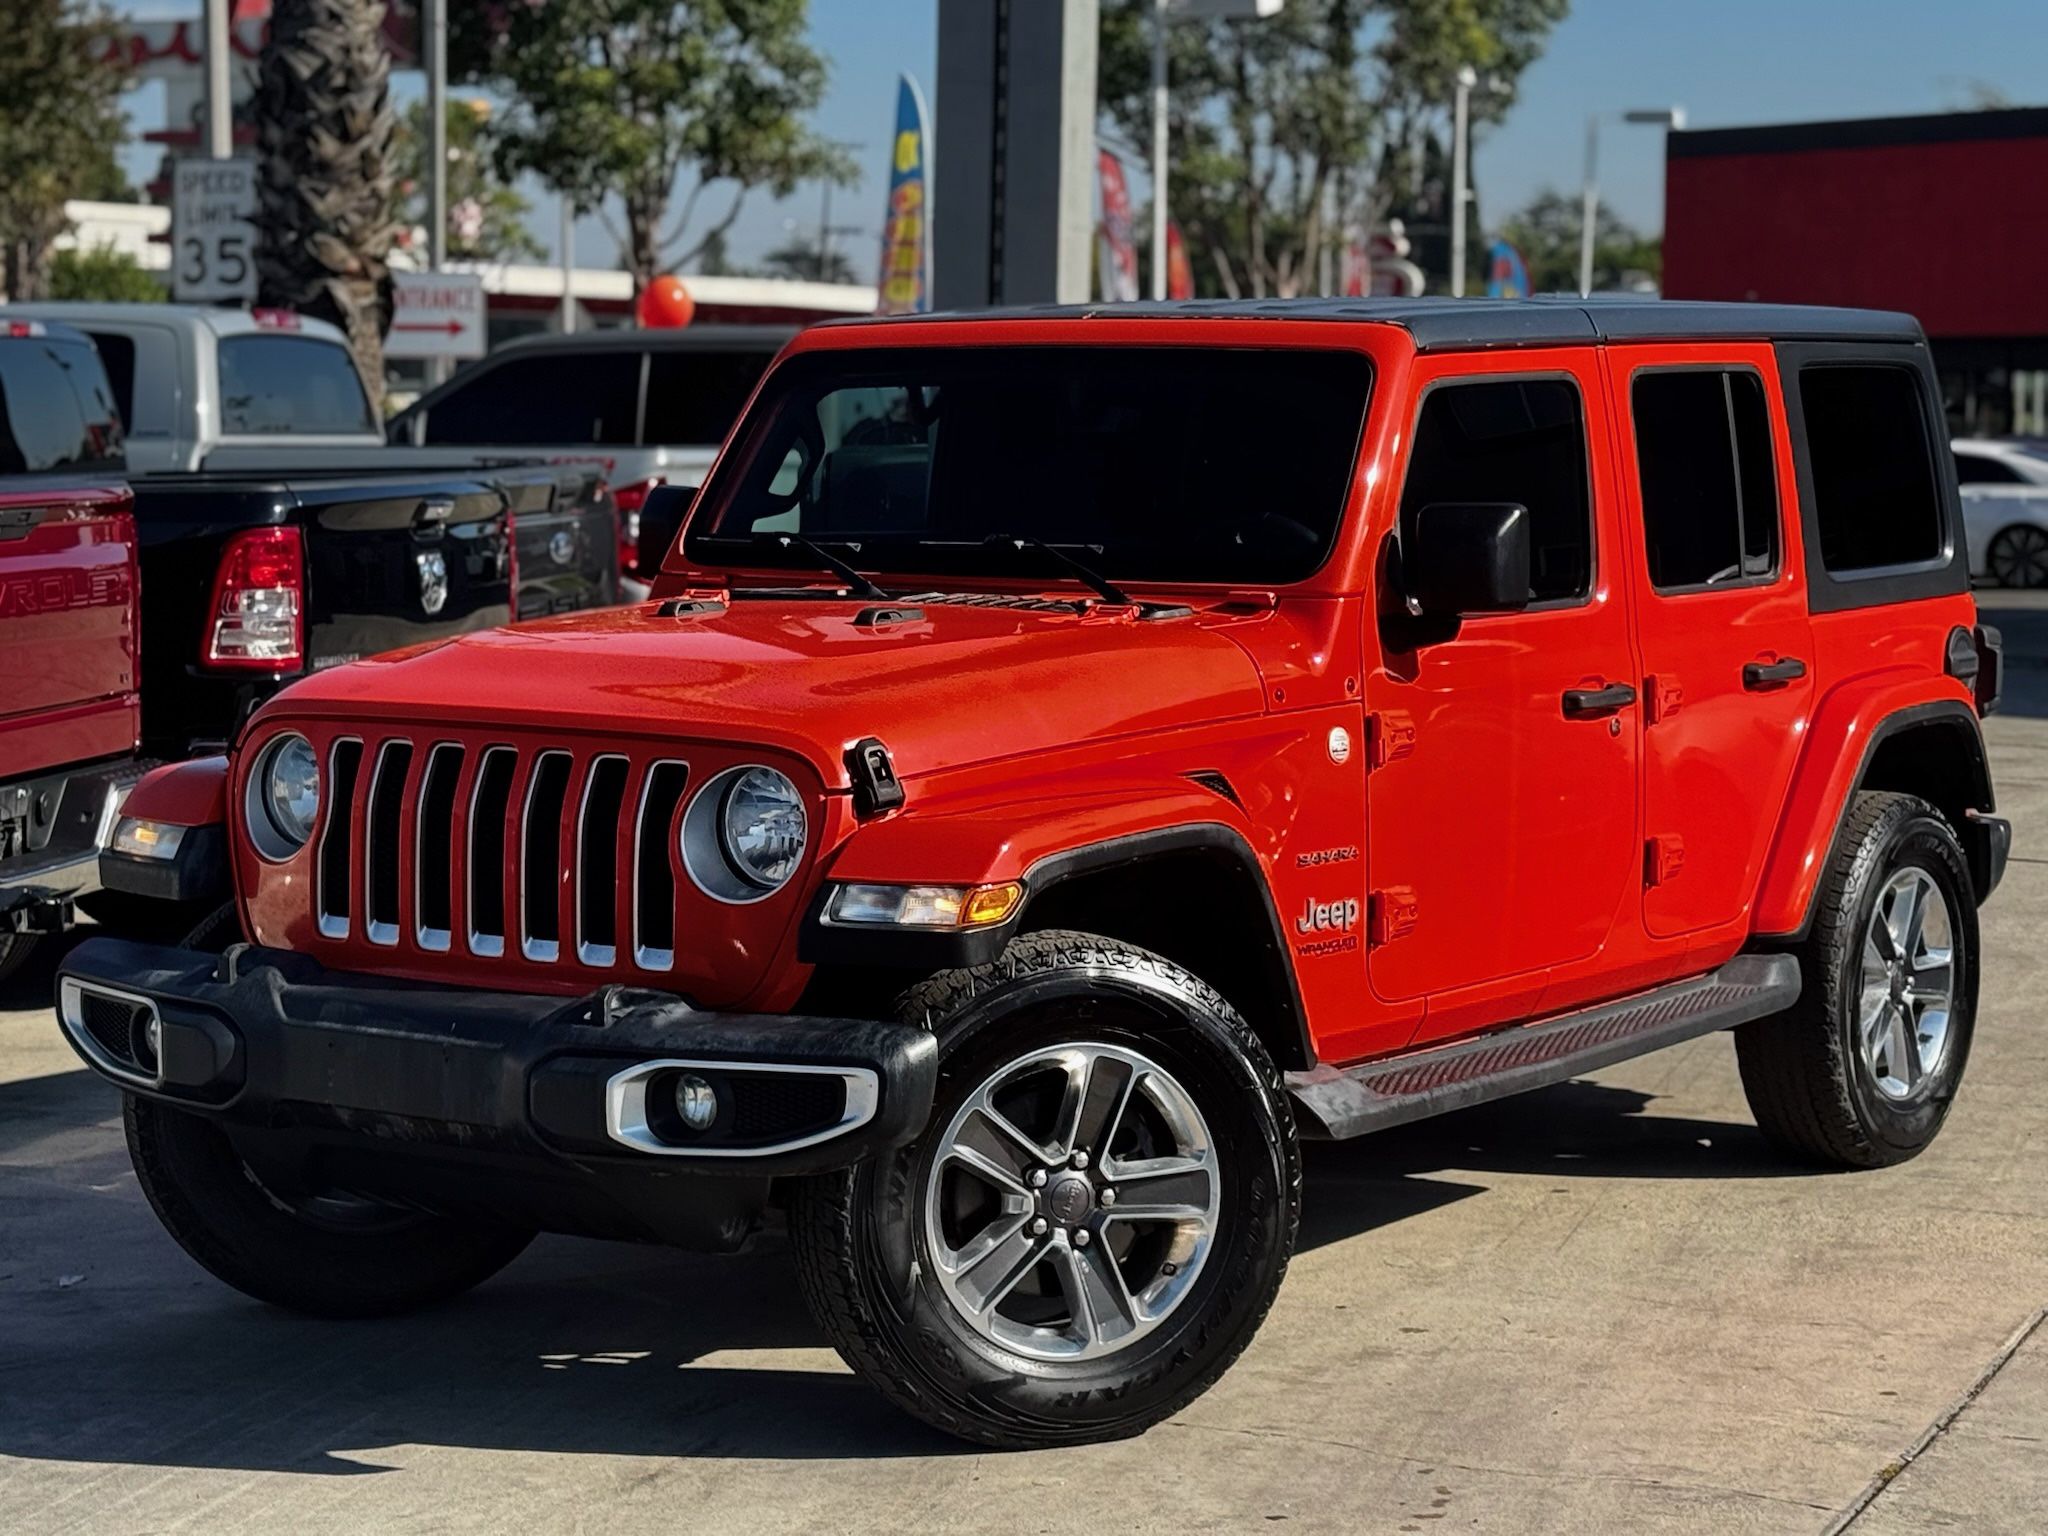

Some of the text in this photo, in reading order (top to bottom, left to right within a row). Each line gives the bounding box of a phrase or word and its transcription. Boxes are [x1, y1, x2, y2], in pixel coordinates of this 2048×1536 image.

[182, 171, 246, 194] SPEED
[185, 205, 237, 225] LIMIT
[183, 237, 247, 285] 35
[1296, 847, 1360, 868] SAHARA
[1296, 897, 1359, 934] Jeep
[1296, 936, 1359, 957] WRANGLER
